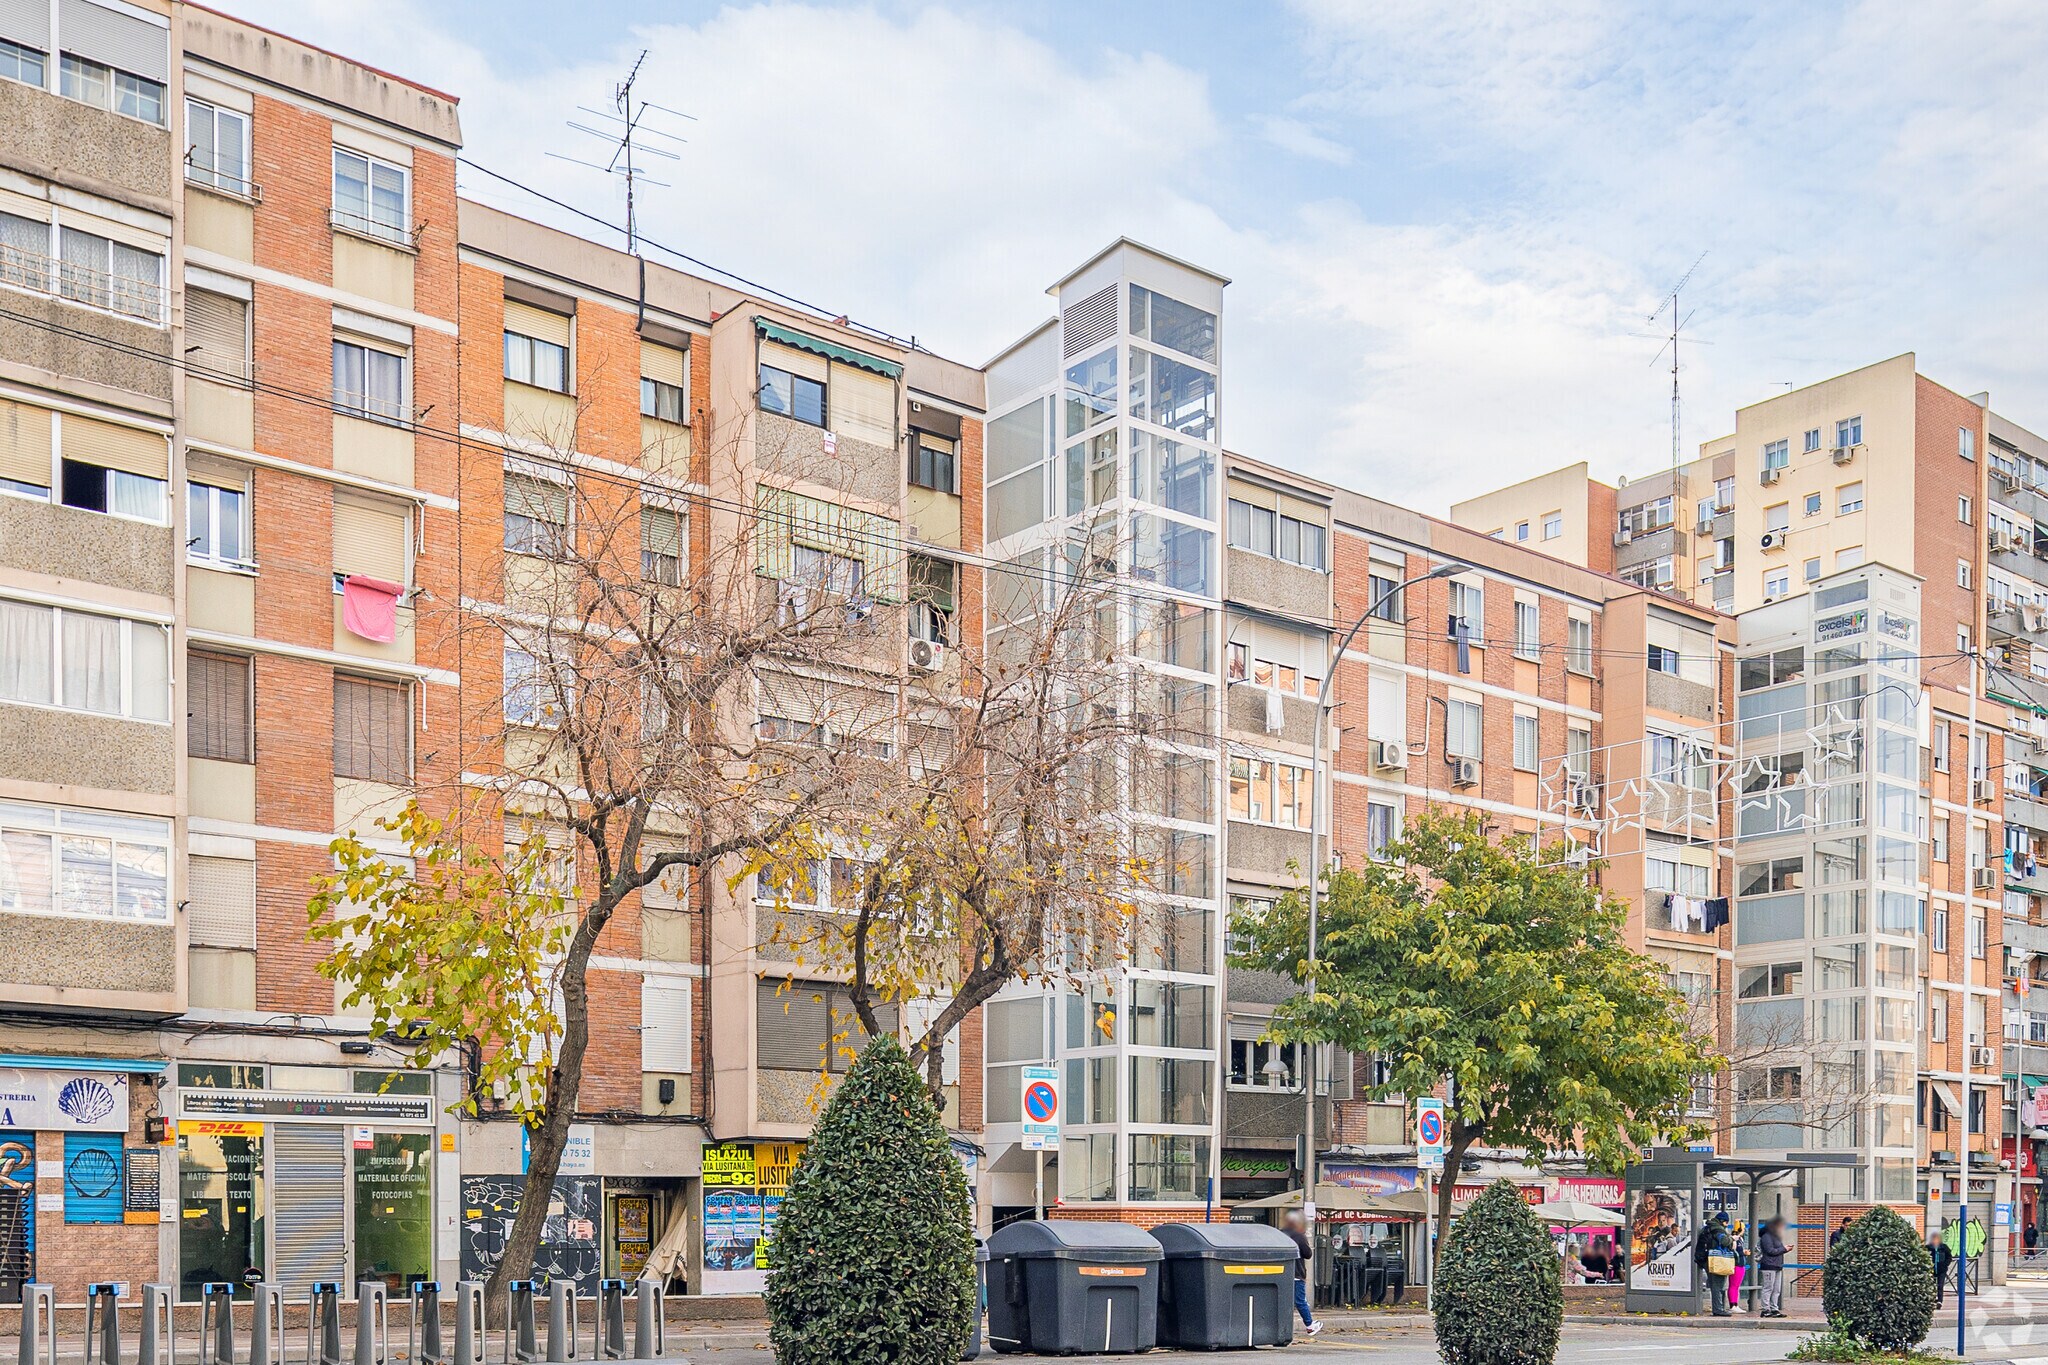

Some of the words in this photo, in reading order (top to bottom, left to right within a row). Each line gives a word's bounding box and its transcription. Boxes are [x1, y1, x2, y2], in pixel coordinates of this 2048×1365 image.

[287, 1103, 333, 1114] Papyre
[198, 1123, 246, 1134] DHL
[567, 1137, 591, 1145] NIBLE
[570, 1149, 579, 1157] 75
[581, 1149, 591, 1157] 32
[705, 1149, 752, 1160] ISLAZUL
[773, 1146, 790, 1164] VIA
[703, 1162, 713, 1170] VIA
[715, 1162, 746, 1170] LUSITANA
[358, 1174, 389, 1182] MATERIAL
[390, 1174, 399, 1182] DE
[400, 1174, 426, 1182] OFICINA
[229, 1191, 252, 1199] TEXTO
[372, 1191, 413, 1199] FOTOCOPIAS
[1560, 1180, 1579, 1200] UÑAS
[1580, 1185, 1618, 1203] HERMOSAS
[1708, 1202, 1715, 1210] DE
[1345, 1210, 1355, 1219] de
[1648, 1263, 1675, 1277] KRAVEN
